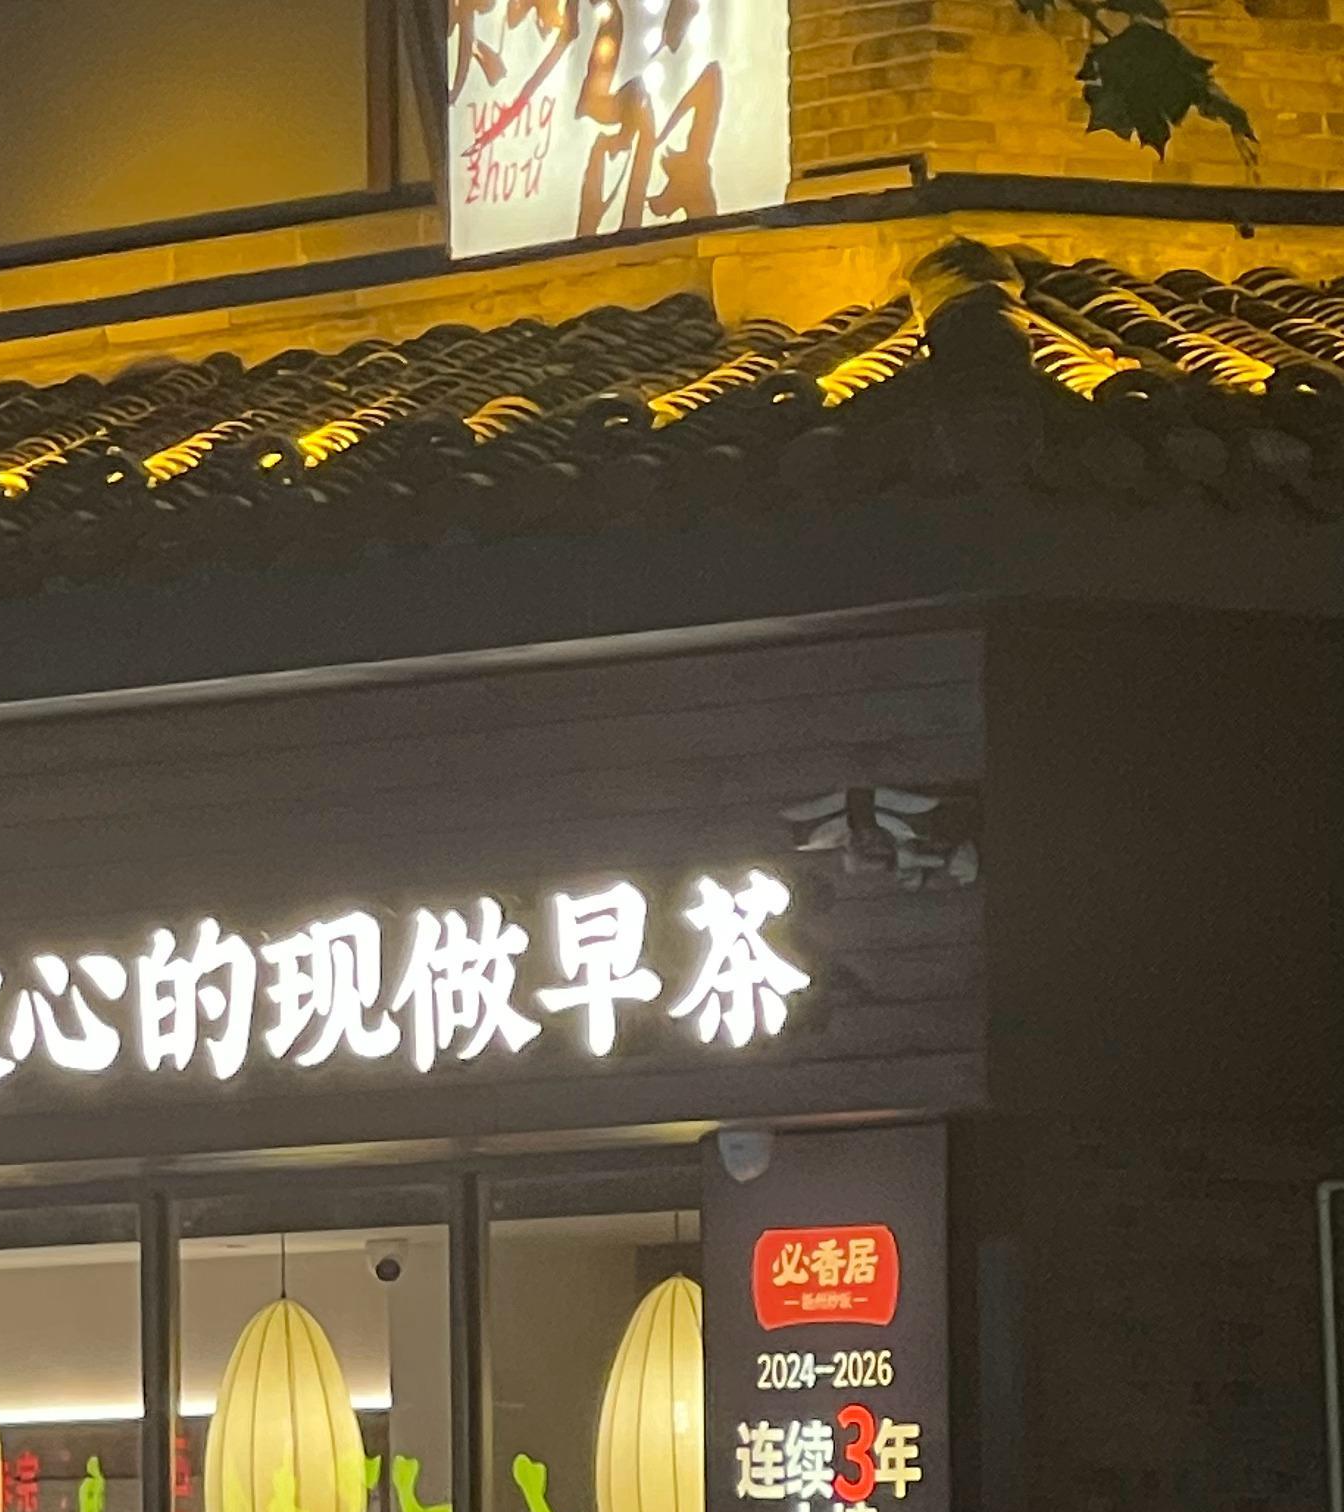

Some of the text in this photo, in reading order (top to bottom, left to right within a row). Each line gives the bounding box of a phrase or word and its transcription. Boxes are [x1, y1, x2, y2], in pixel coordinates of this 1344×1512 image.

[772, 1238, 879, 1288] 必香居
[735, 1402, 922, 1502] 连续3年
